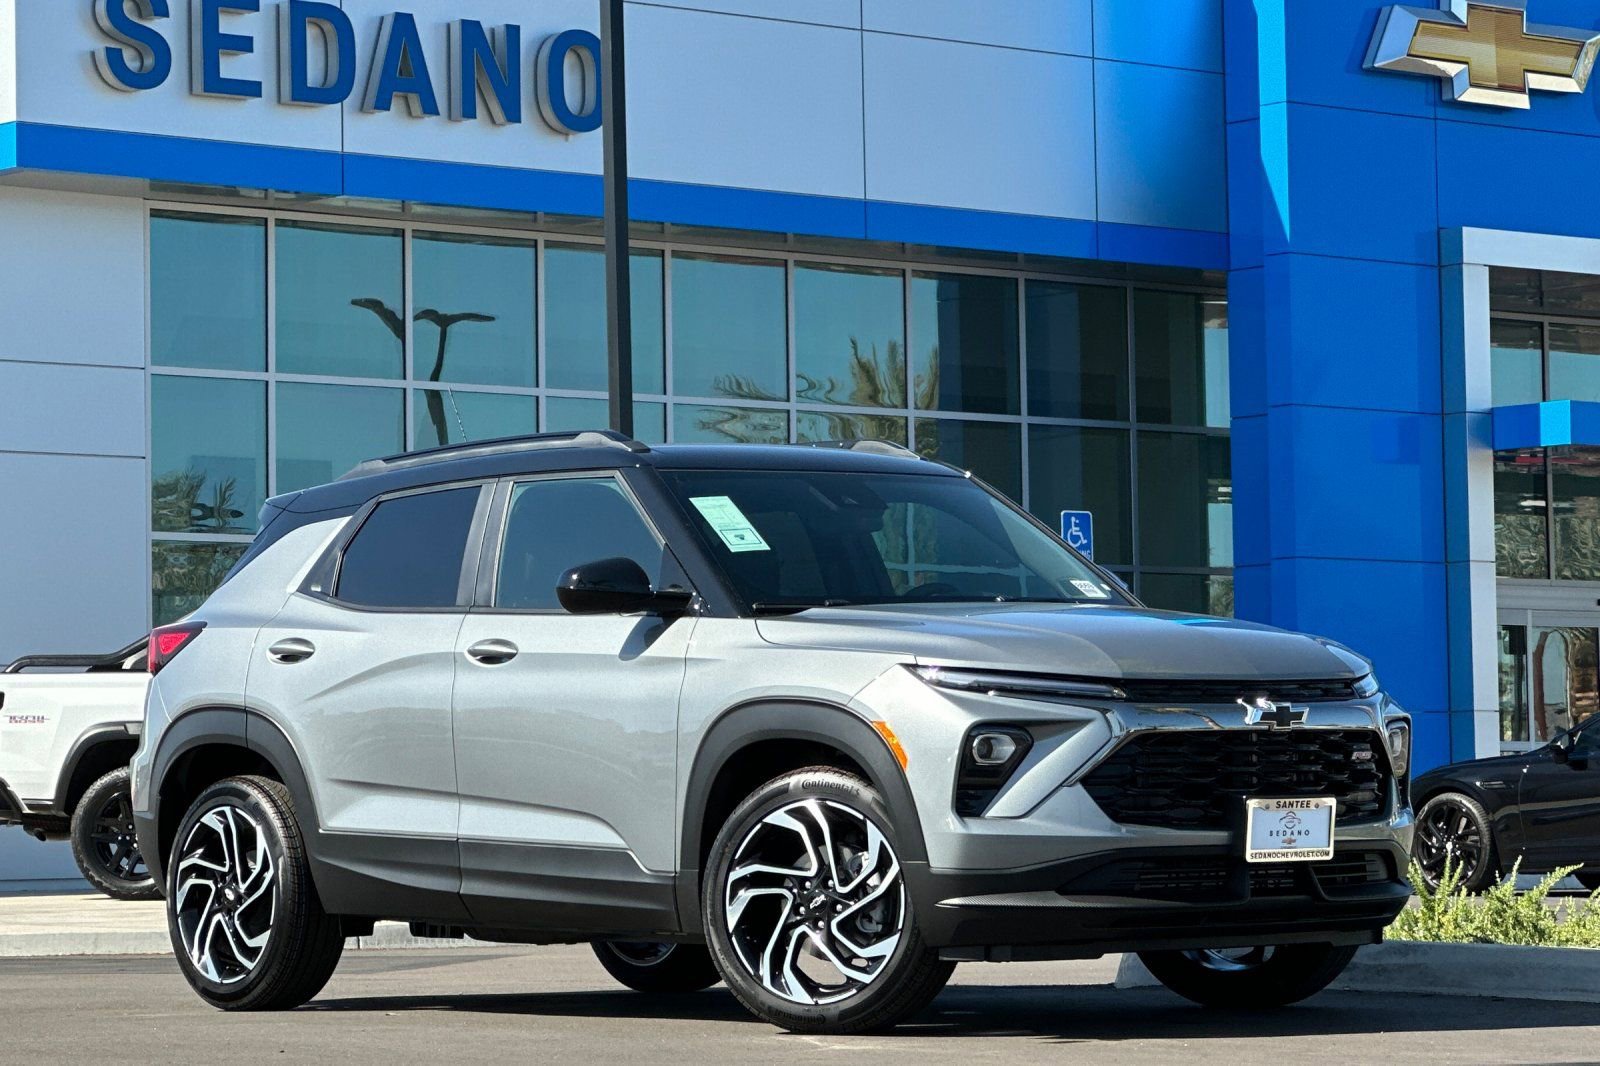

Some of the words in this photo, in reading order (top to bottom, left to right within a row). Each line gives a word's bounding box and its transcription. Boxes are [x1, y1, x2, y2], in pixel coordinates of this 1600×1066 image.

[93, 0, 602, 135] SEDANO
[801, 779, 854, 793] Continental
[1275, 800, 1311, 809] SANTEE
[1269, 829, 1310, 837] SEDANO
[1250, 850, 1330, 860] SEDANOCHEVROLET.COM
